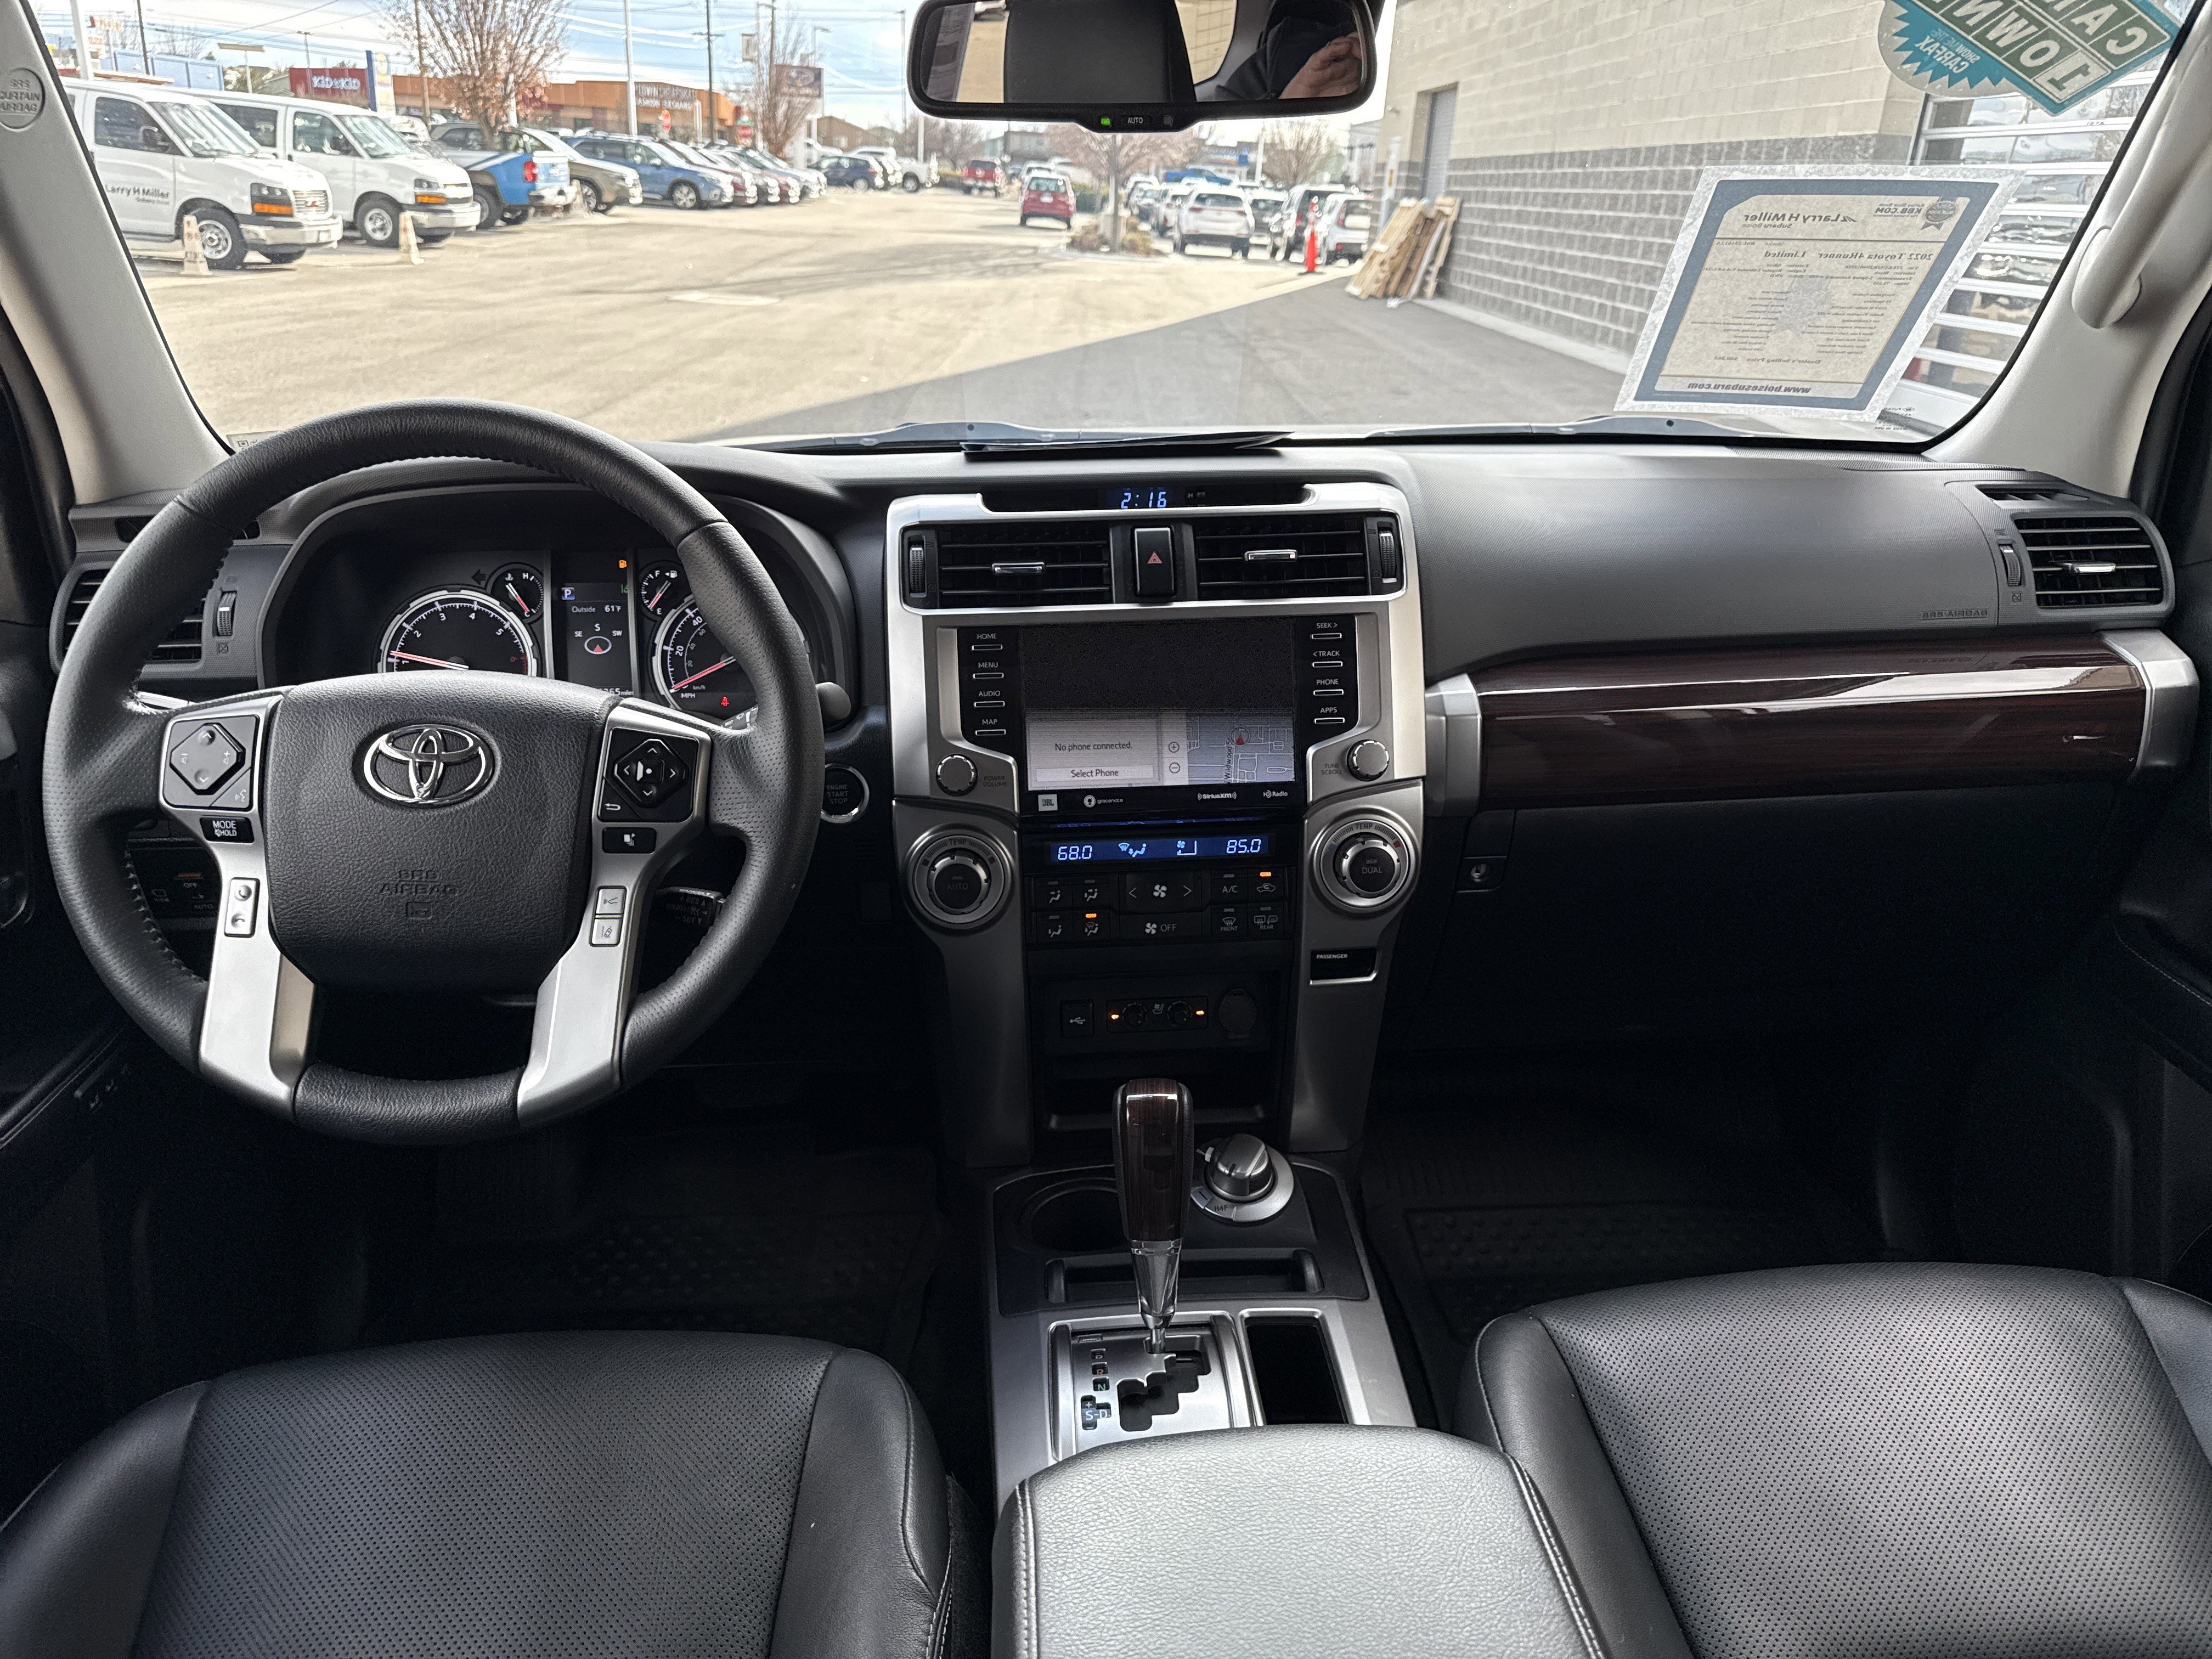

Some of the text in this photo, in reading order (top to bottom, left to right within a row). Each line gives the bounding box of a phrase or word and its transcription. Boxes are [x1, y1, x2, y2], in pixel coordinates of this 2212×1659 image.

[10, 79, 30, 88] SRS
[1121, 492, 1166, 509] 2:16
[565, 589, 571, 599] P
[439, 612, 446, 621] 3
[594, 623, 601, 631] S
[675, 616, 703, 657] 20 40
[1068, 743, 1091, 752] phone
[1093, 741, 1133, 750] connected.
[1071, 768, 1119, 777] Select Phone
[212, 820, 237, 829] MODE
[1227, 839, 1261, 853] 85.0
[1058, 845, 1092, 860] 68.0
[379, 883, 459, 895] AIRBAG
[1160, 924, 1177, 932] OFF
[1097, 1383, 1106, 1391] N
